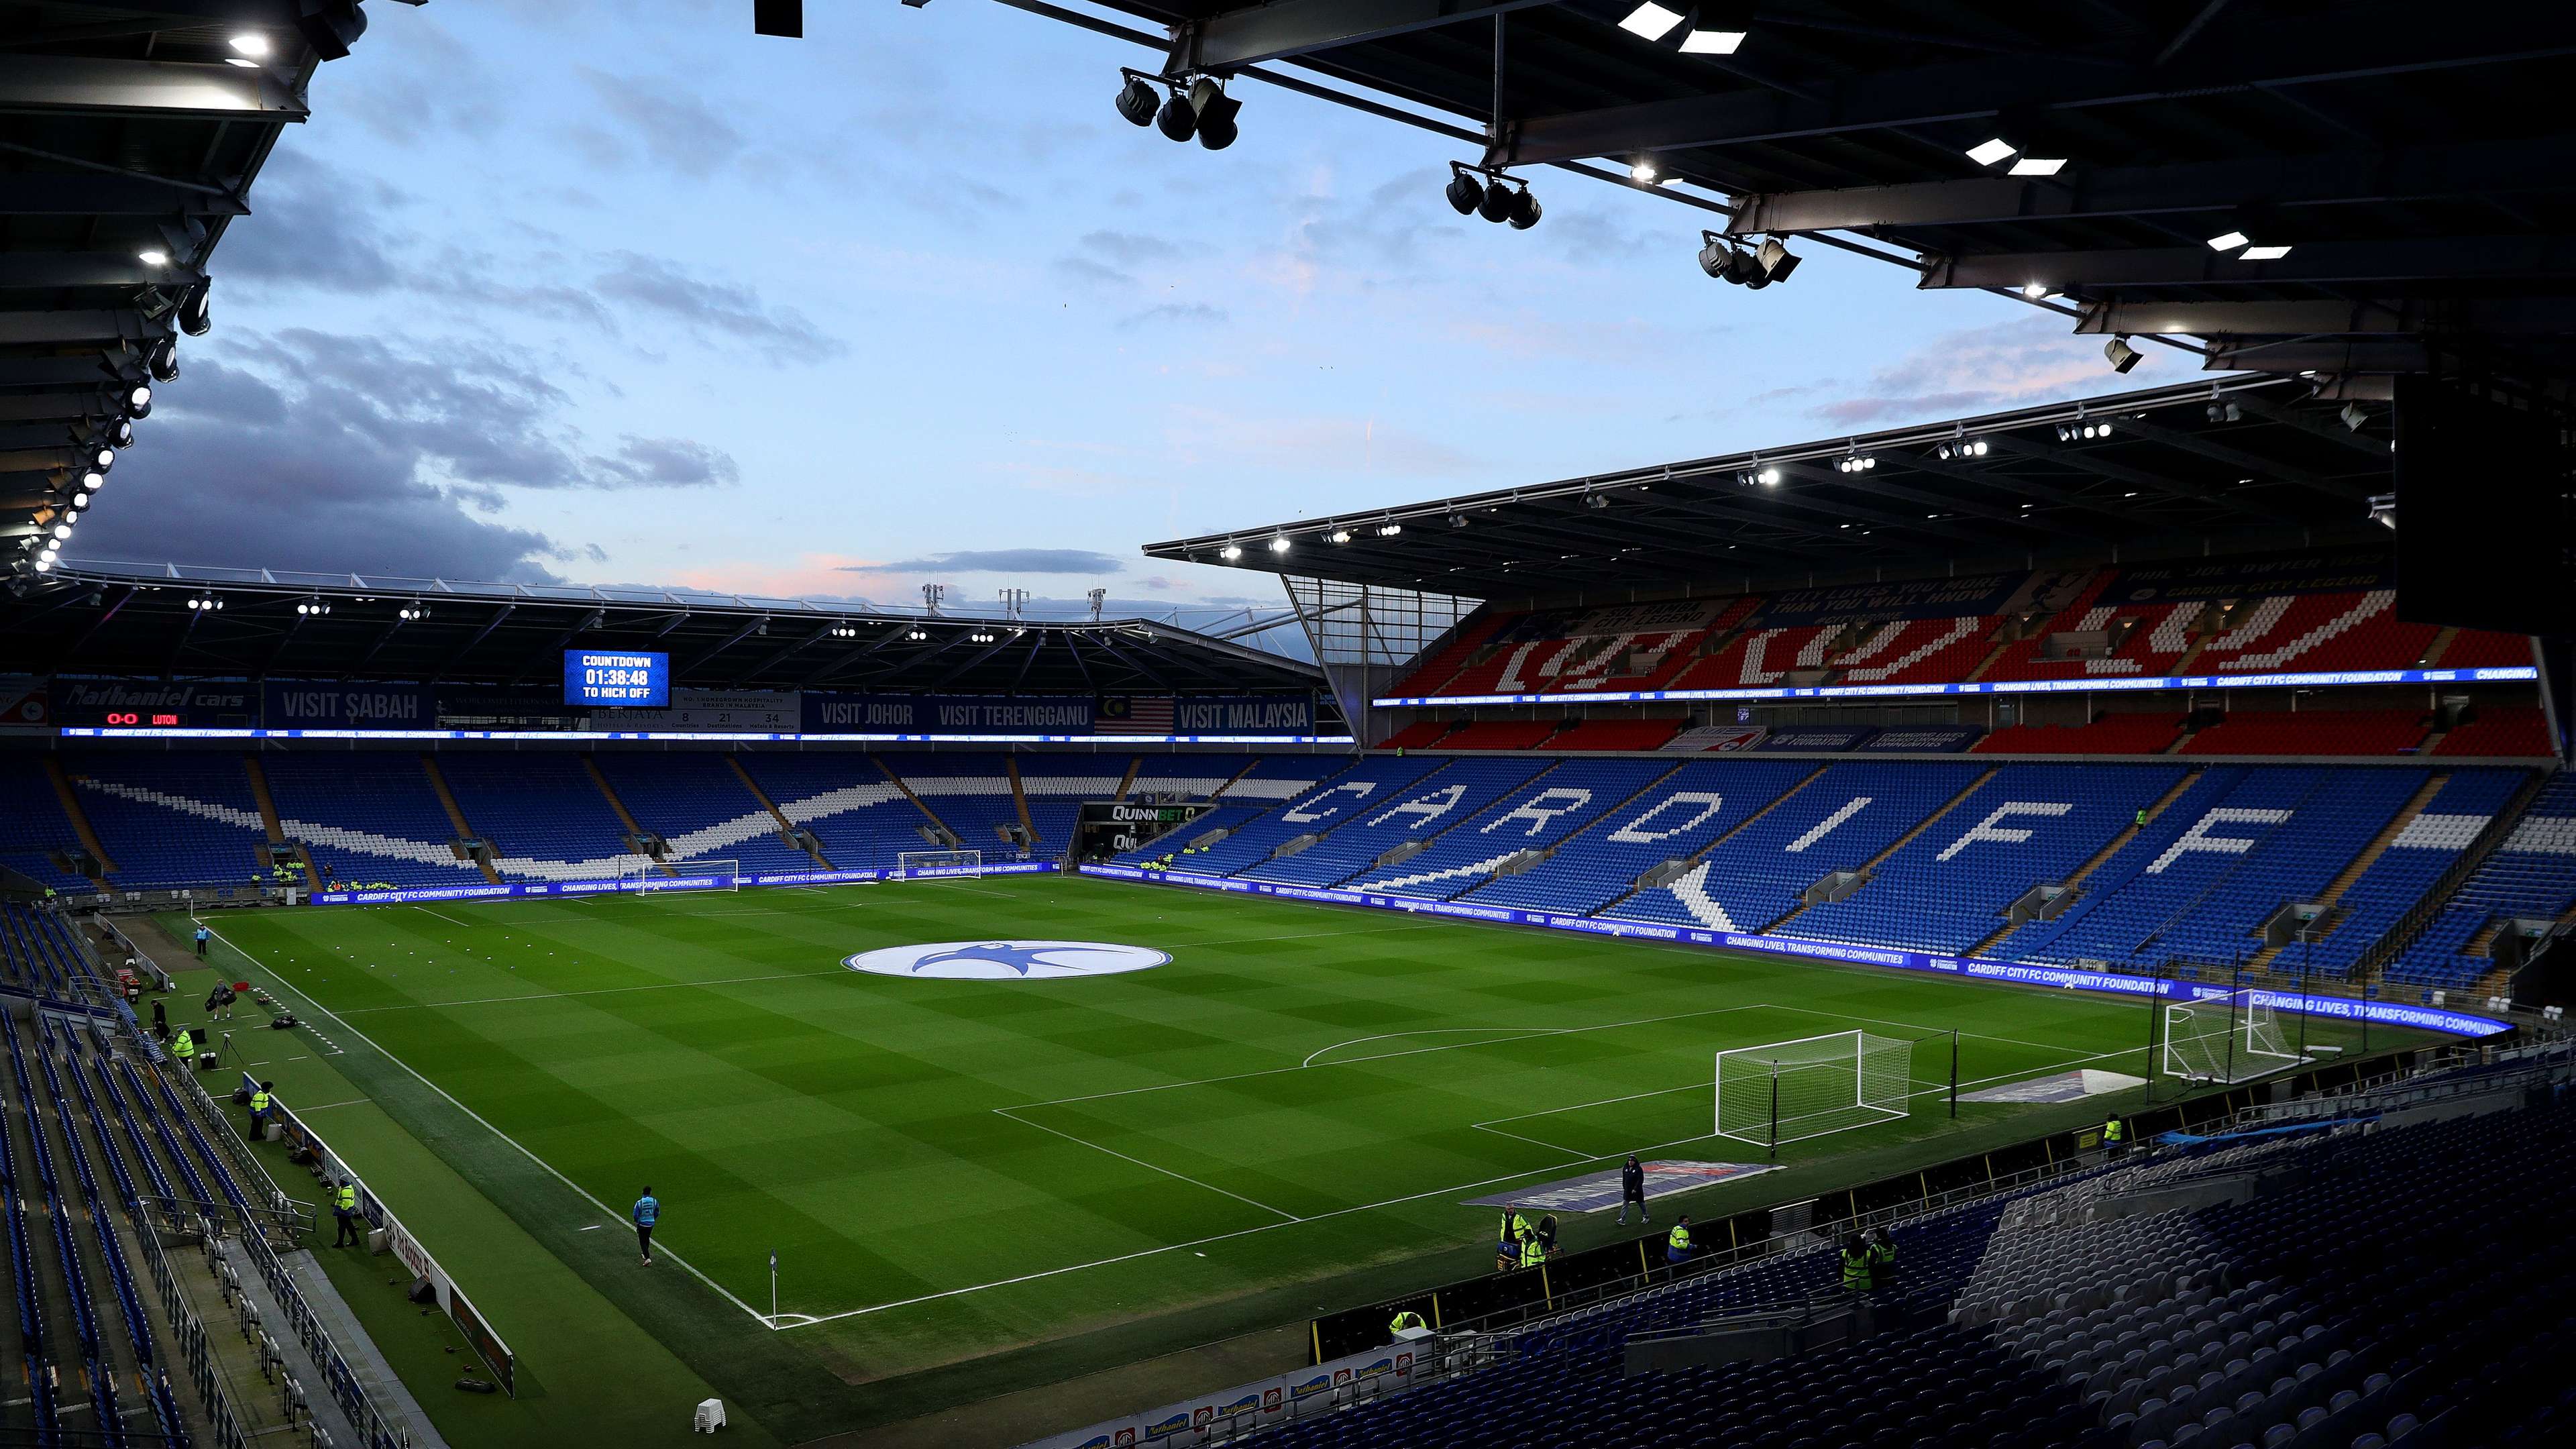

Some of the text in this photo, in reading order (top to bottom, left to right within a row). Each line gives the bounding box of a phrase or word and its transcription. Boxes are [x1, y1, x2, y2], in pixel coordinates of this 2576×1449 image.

[2240, 558, 2322, 574] DWYER
[1781, 574, 2006, 602] CITY LOVES YOU MORE
[2248, 581, 2292, 593] CITY
[2298, 575, 2379, 588] LEGEND
[1771, 589, 1994, 614] THAN YOU WILL KNOW
[1595, 611, 1706, 628] CITY LEGEND
[582, 655, 651, 667] COUNTDOWN
[586, 669, 648, 686] 01:38:48
[2216, 677, 2253, 686] CARDIFF
[2252, 676, 2273, 684] CITY
[2272, 675, 2286, 684] FC
[2285, 674, 2341, 684] COMMUNITY
[2341, 672, 2403, 683] FOUNDATION
[2477, 669, 2532, 680] CHANGING
[583, 686, 651, 698] TO KICK OFF
[1866, 686, 1905, 694] COMMUNITY
[1994, 683, 2031, 692] CHANGING
[2052, 680, 2110, 690] TRANSFORMING
[2109, 679, 2164, 688] COMMUNITIES
[66, 684, 195, 706] Nathaniel
[283, 692, 419, 719] VISIT SABAH
[598, 708, 664, 720] BERJAYA
[821, 702, 913, 725] VISIT JOHOR
[152, 714, 179, 725] LUTON
[682, 712, 689, 722] 8
[718, 713, 731, 722] 21
[765, 714, 780, 722] 34
[939, 704, 1088, 727] VISIT TERENGGANU
[1179, 702, 1308, 729] VISIT MALAYSIA
[1282, 782, 2294, 875] CARDIFF
[804, 873, 842, 881] COMMUNITY
[841, 871, 877, 879] FOUNDATION
[1002, 864, 1038, 872] COMMUNITIES
[357, 892, 390, 901] CARDIFF
[390, 892, 409, 900] CITY
[408, 891, 419, 899] FC
[418, 890, 464, 898] COMMUNITY
[464, 887, 511, 896] FOUNDATION
[562, 883, 598, 892] CHANGING
[597, 883, 617, 891] LIVES,
[668, 879, 713, 887] COMMUNITIES
[1307, 890, 1334, 900] COMMUNITY
[1333, 892, 1362, 903] FOUNDATION
[1394, 900, 1419, 910] CHANGING
[1419, 904, 1434, 912] LIVES,
[1434, 904, 1473, 916] TRANSFORMING
[1473, 908, 1509, 920] COMMUNITIES
[1550, 916, 1576, 927] CARDIFF
[1575, 919, 1590, 928] CITY
[1589, 920, 1598, 929] FC
[1597, 922, 1636, 933] COMMUNITY
[1635, 926, 1677, 938] FOUNDATION
[1726, 936, 1764, 949] CHANGING
[1764, 941, 1786, 952] LIVES,
[1787, 942, 1847, 958] TRANSFORMING
[1846, 949, 1904, 964] COMMUNITIES
[1968, 963, 2169, 994] CARDIFF CITY FC COMMUNITY FOUNDATION
[2252, 994, 2315, 1010] CHANGING
[2315, 1000, 2351, 1017] LIVES,
[1293, 1379, 1329, 1396] Nathaniel
[1148, 1417, 1188, 1436] Nathaniel
